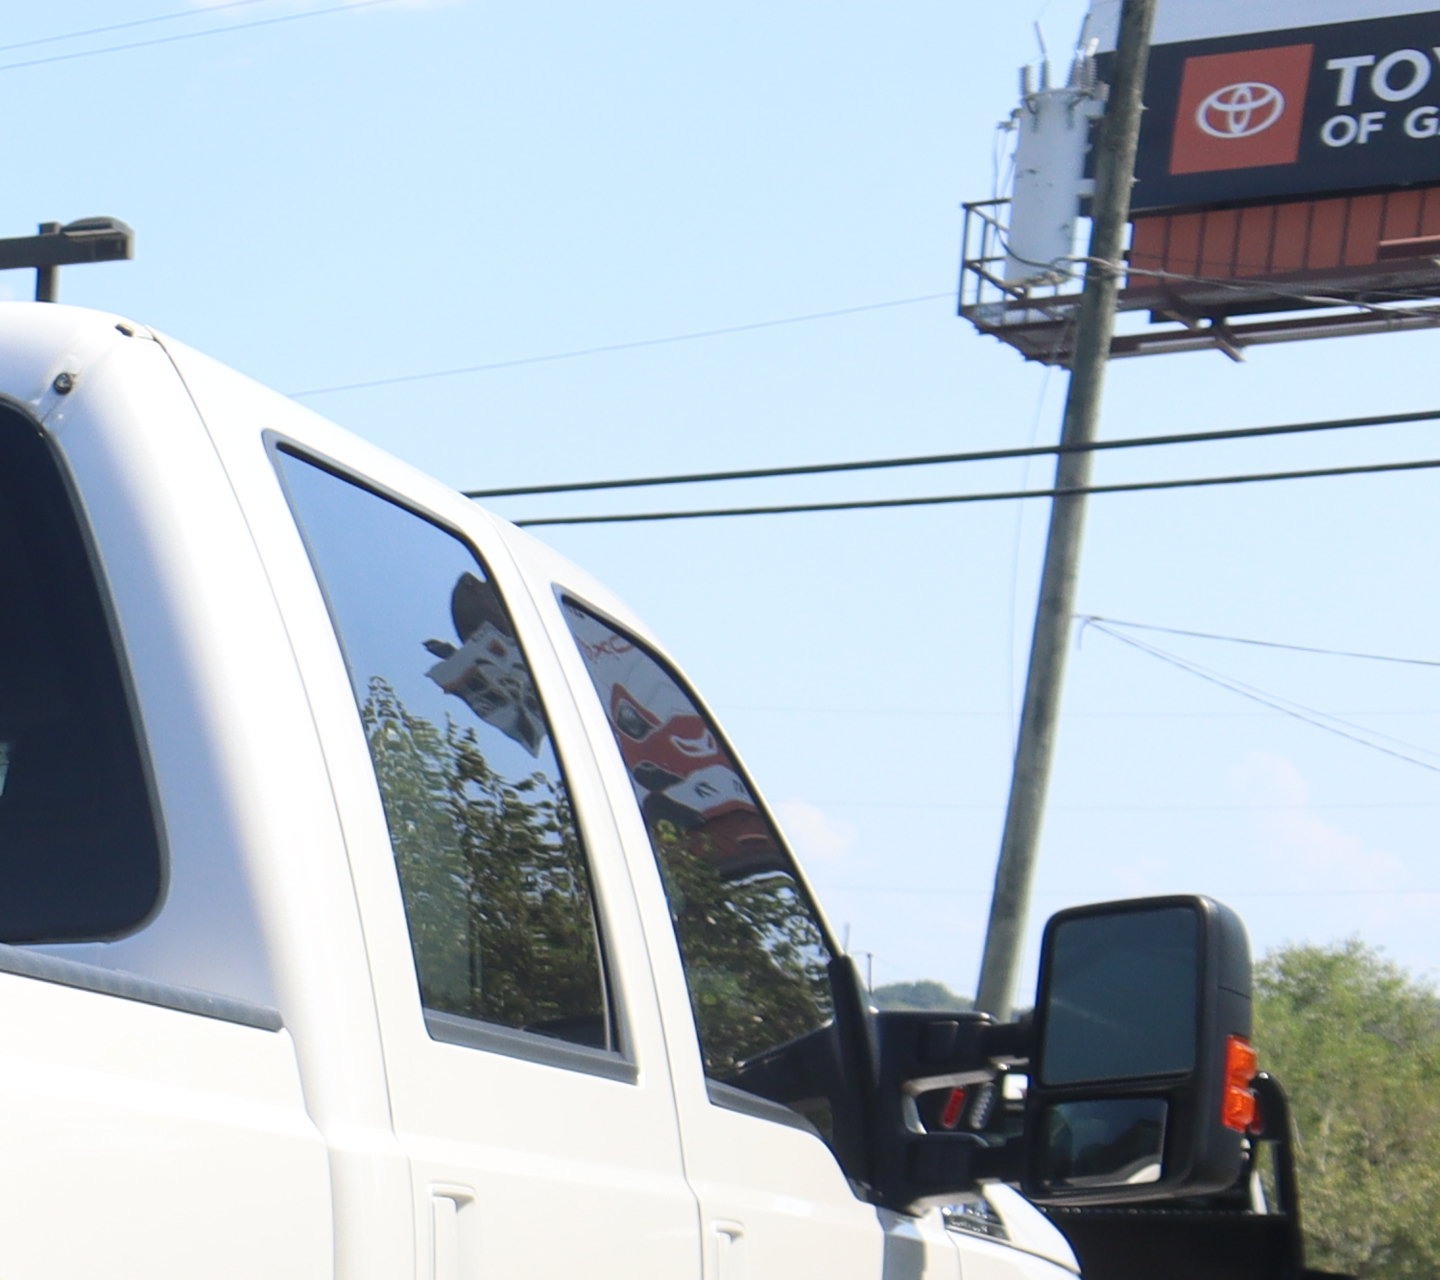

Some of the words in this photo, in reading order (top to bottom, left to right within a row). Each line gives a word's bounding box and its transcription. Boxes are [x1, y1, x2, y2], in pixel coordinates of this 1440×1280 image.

[1325, 47, 1440, 107] TO
[1321, 111, 1387, 148] OF
[1404, 105, 1440, 140] G
